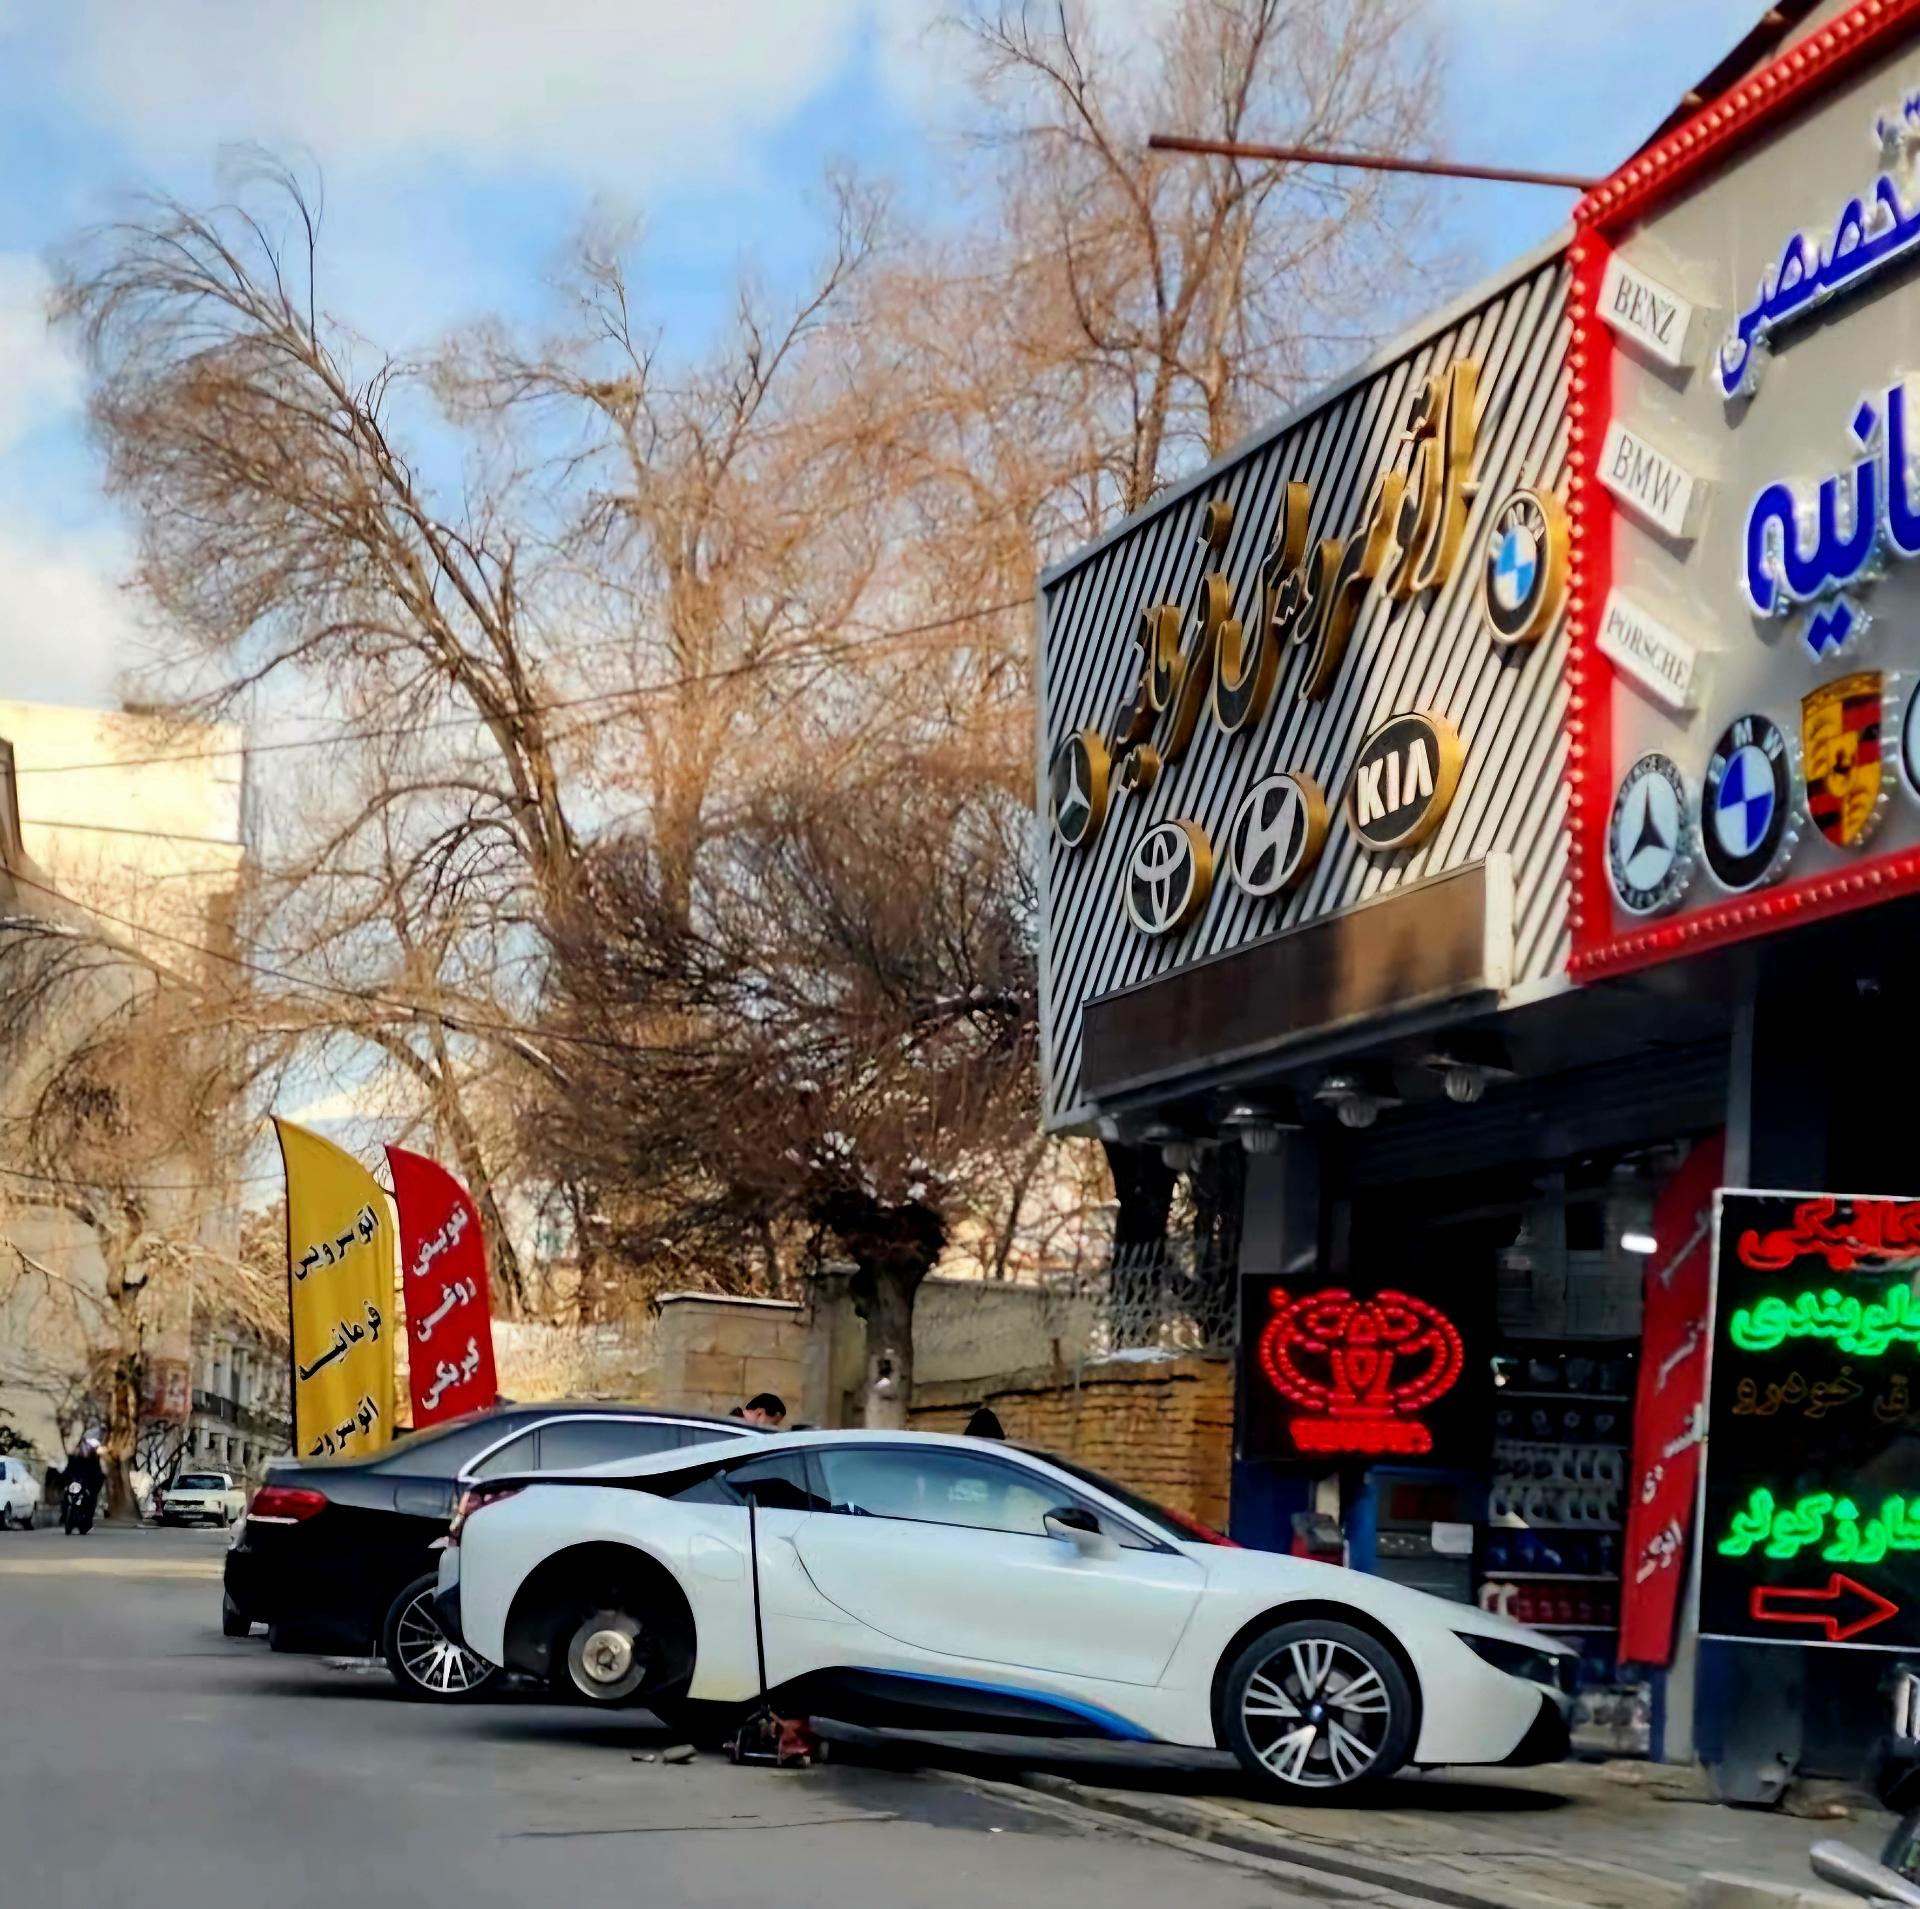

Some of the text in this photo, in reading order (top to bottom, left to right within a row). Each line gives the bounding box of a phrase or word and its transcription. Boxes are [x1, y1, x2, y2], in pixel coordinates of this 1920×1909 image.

[1718, 92, 1920, 395] خصصی
[1613, 273, 1677, 346] BENZ
[1612, 433, 1681, 515] BMW
[1745, 383, 1920, 658] انیه
[1606, 607, 1689, 695] PORSCHE
[1355, 736, 1435, 827] KIA
[1731, 1284, 1920, 1355] لوبندی
[1717, 1487, 1834, 1559] کولر
